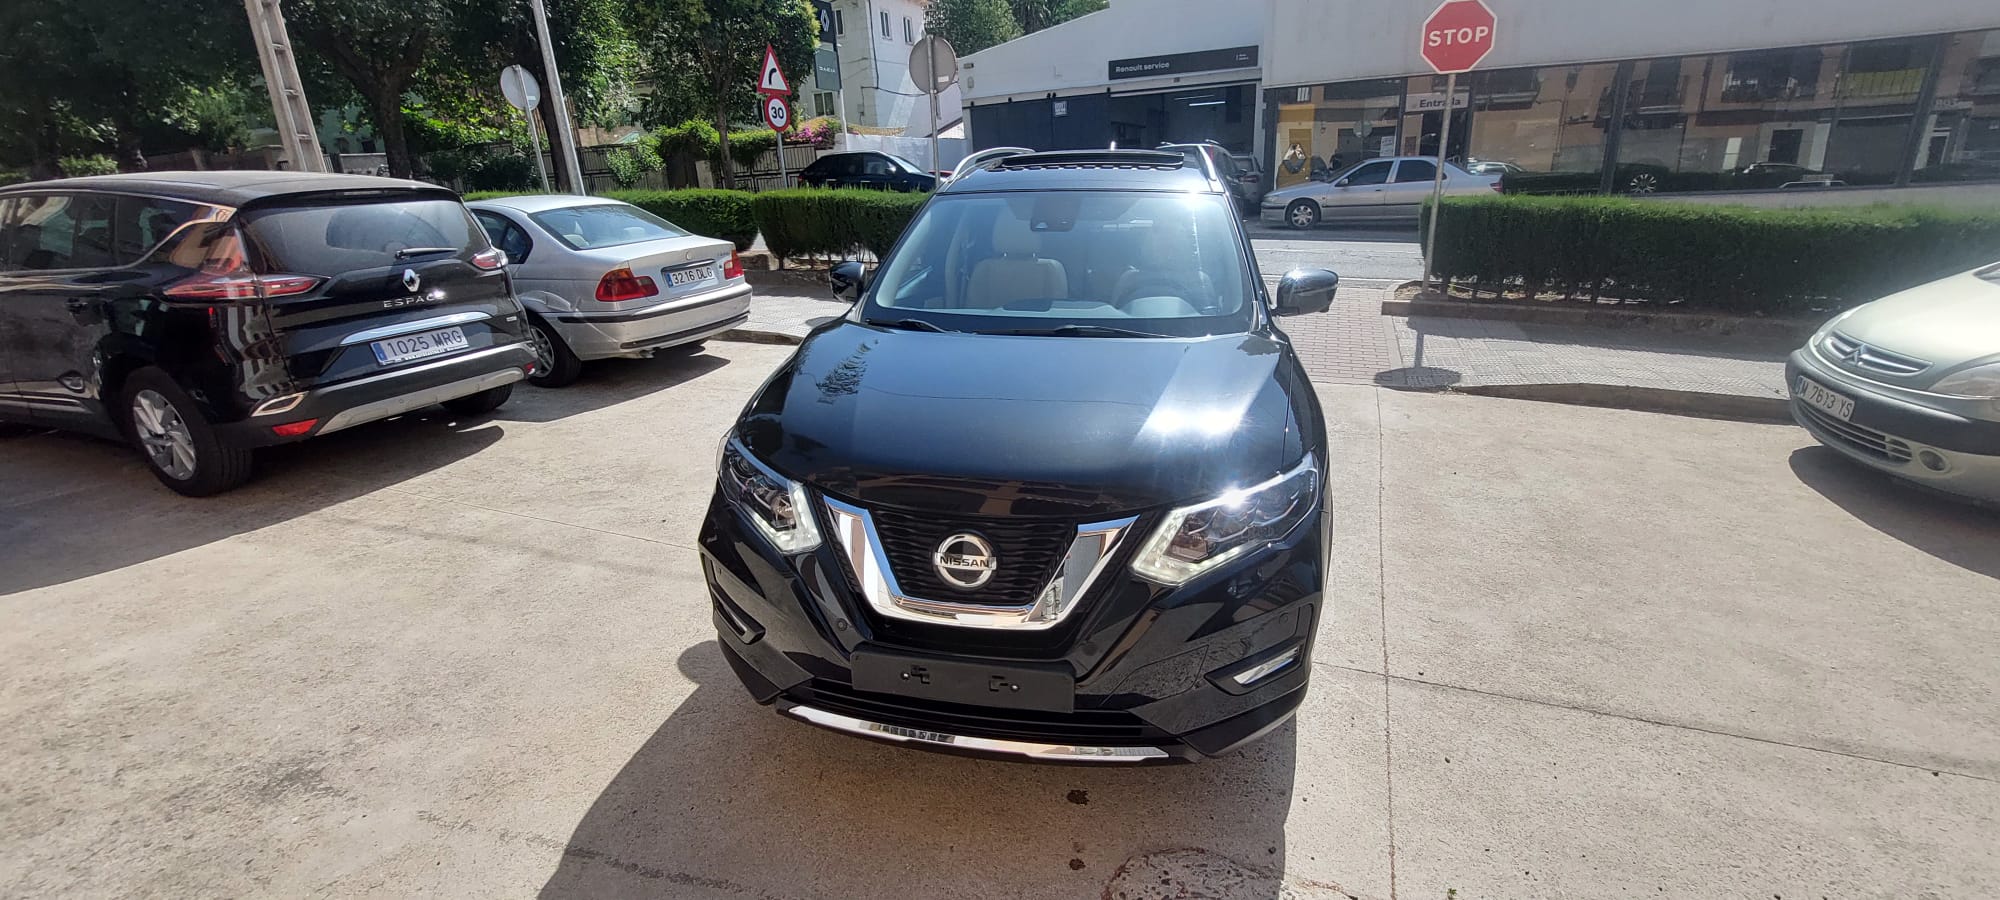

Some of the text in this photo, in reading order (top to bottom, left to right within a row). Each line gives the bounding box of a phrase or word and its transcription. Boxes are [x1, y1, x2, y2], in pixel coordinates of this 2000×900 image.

[1428, 26, 1489, 47] STOP
[1115, 62, 1170, 73] Renault service
[1420, 97, 1462, 107] Entraa
[770, 106, 785, 119] 30
[672, 270, 696, 285] 3216
[387, 336, 430, 357] 1025
[431, 330, 462, 348] MRG
[1838, 399, 1853, 418] YS
[940, 555, 990, 569] NISSAN
